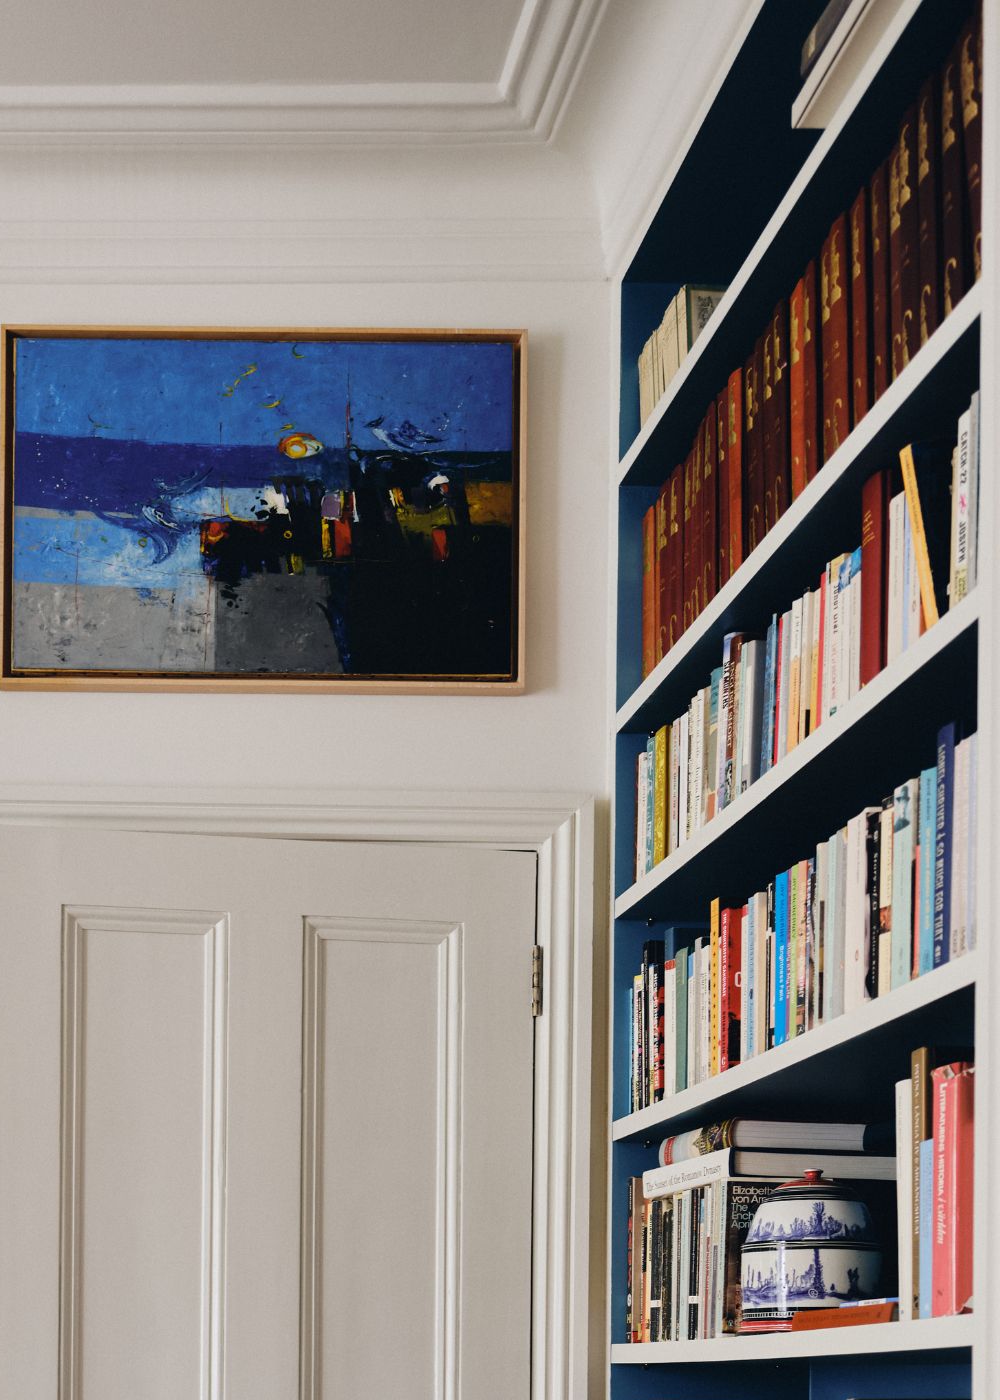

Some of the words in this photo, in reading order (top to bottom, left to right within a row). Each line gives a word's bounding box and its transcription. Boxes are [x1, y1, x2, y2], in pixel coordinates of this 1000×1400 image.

[960, 432, 968, 486] CATCH-22
[958, 522, 966, 563] JOSEPH
[937, 744, 946, 782] LIONEL
[936, 784, 945, 830] SHRIVER
[936, 843, 945, 856] SO
[935, 860, 944, 890] MUCH
[872, 886, 877, 896] of
[935, 892, 944, 912] FOR
[934, 914, 943, 941] THAT
[937, 1154, 945, 1196] HISTORIA
[732, 1186, 774, 1194] Elizabeth
[731, 1203, 749, 1212] The
[731, 1220, 752, 1230] April
